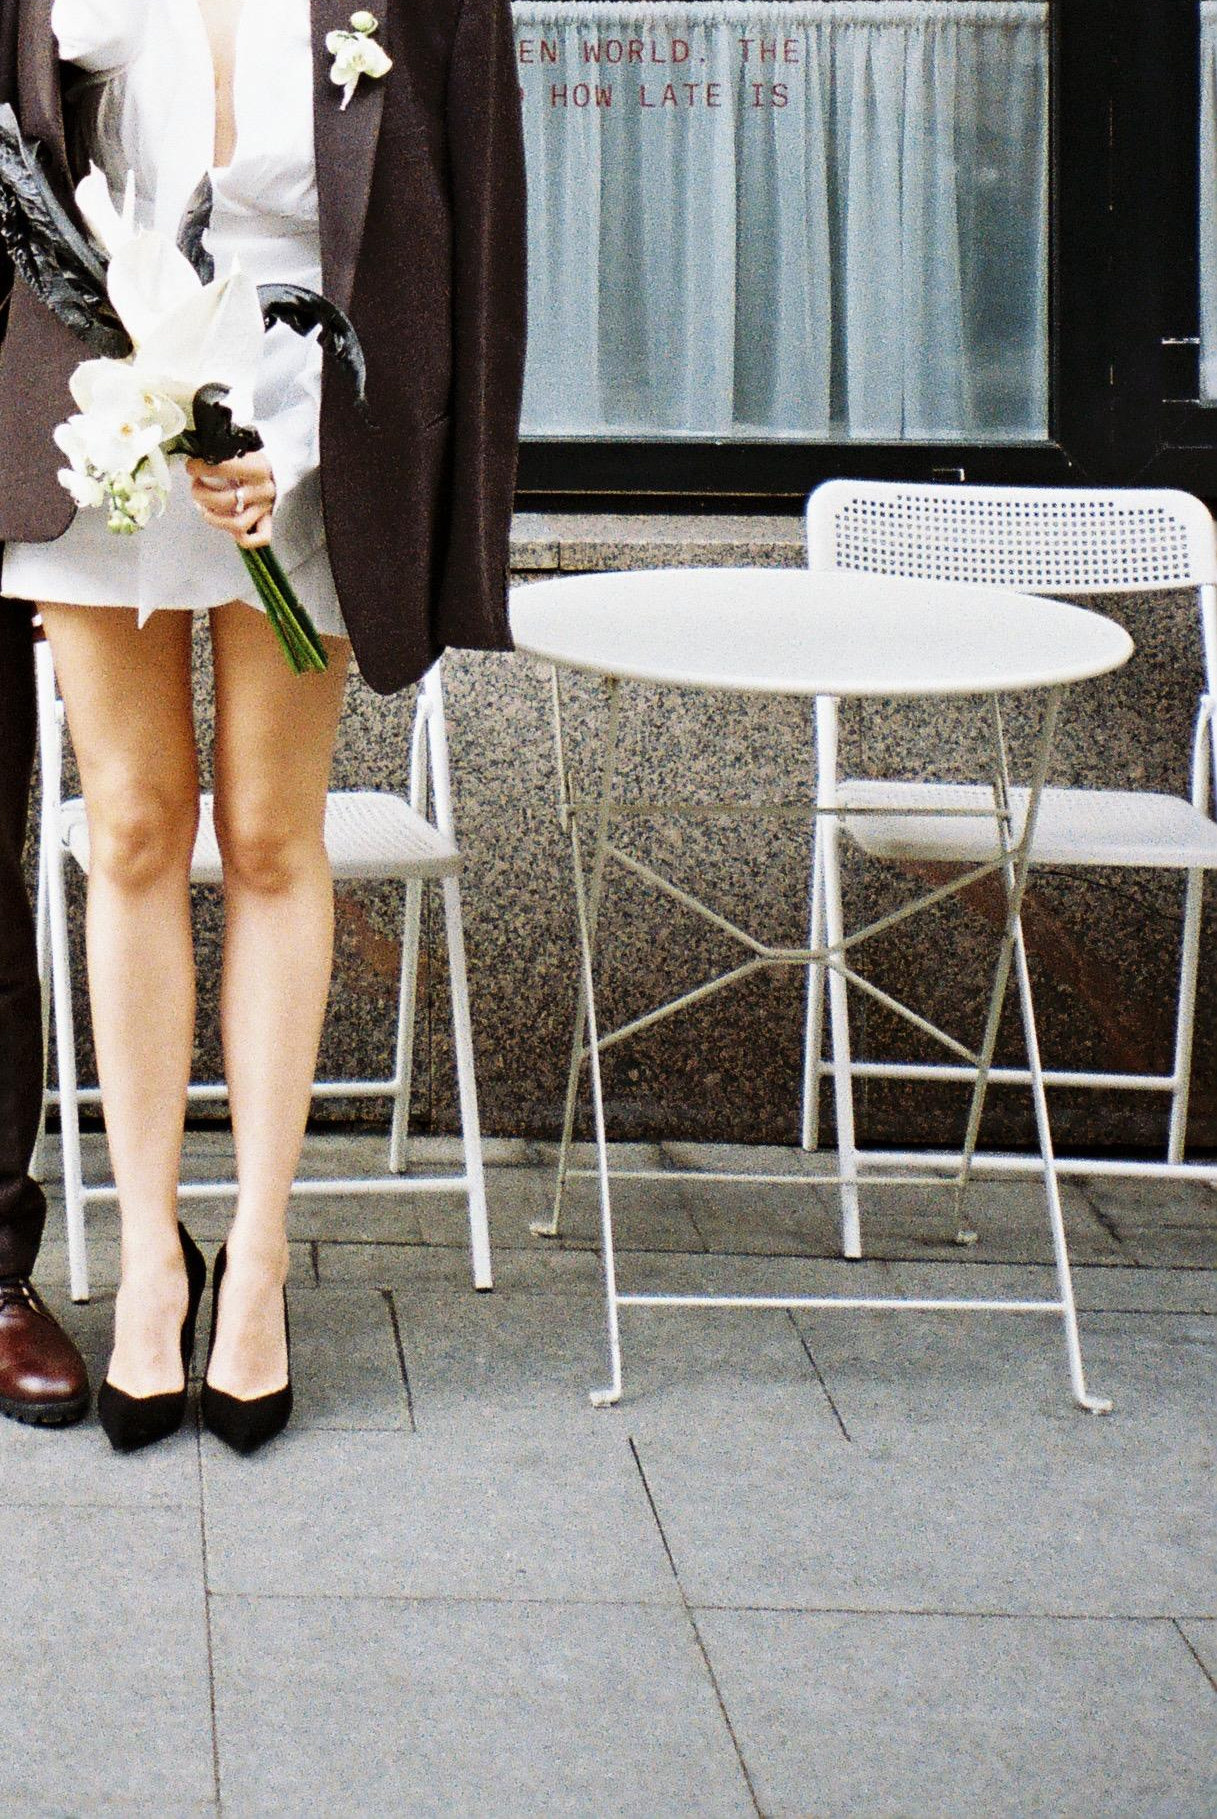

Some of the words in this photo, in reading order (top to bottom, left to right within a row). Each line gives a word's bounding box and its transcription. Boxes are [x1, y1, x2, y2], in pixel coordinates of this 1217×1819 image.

[737, 38, 800, 64] THE
[550, 82, 613, 108] HOW
[638, 82, 722, 108] LATE
[751, 82, 790, 108] IS
